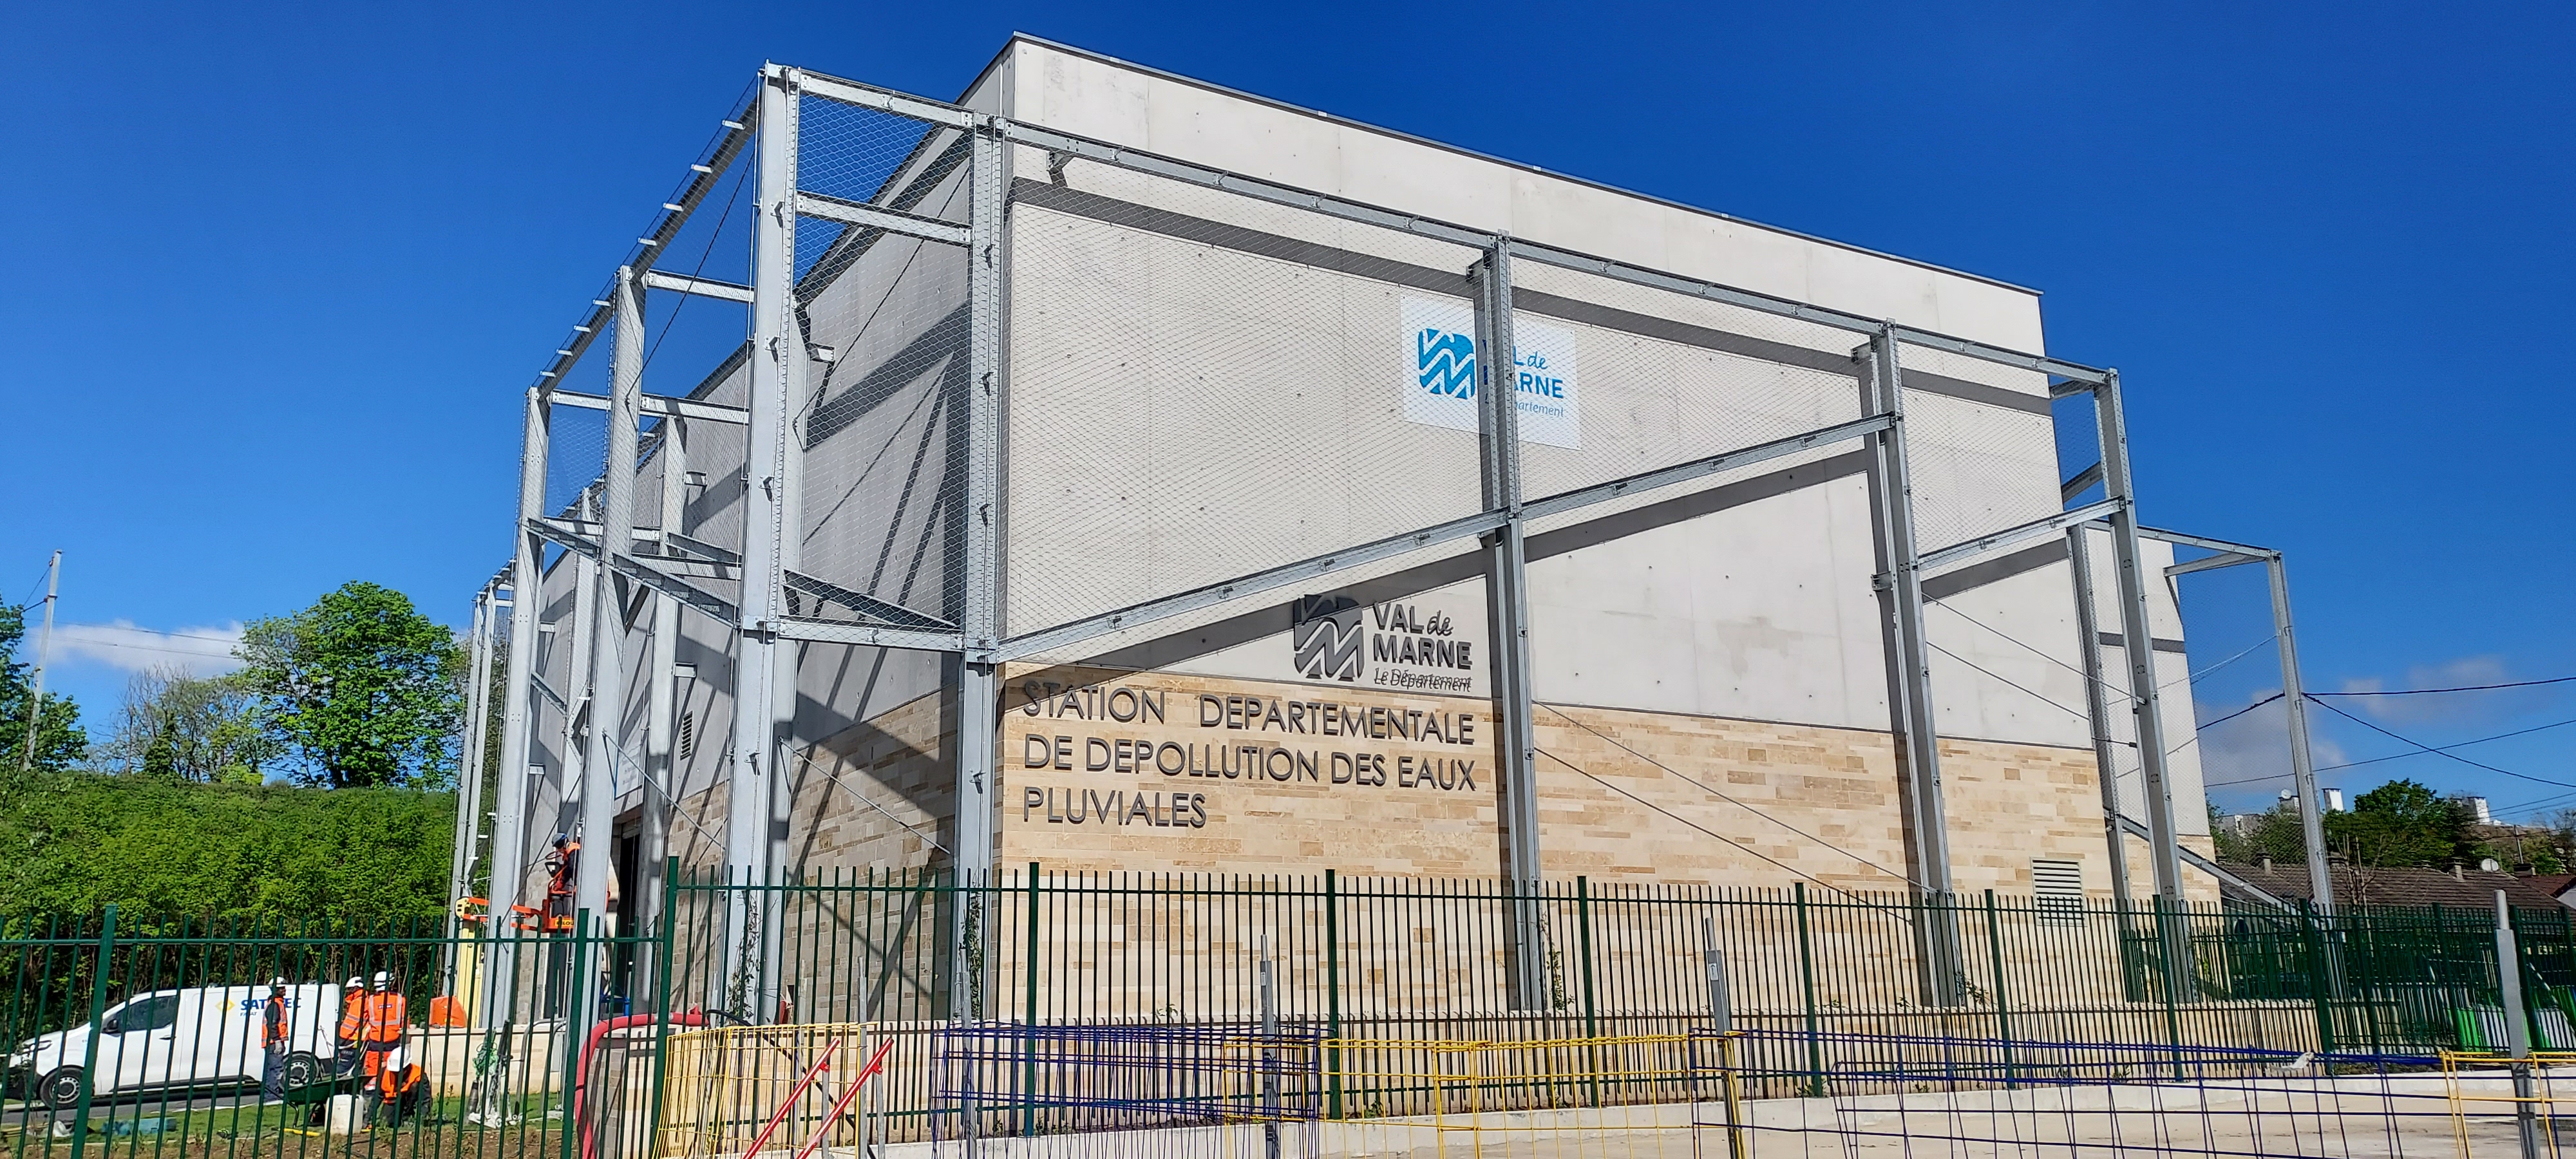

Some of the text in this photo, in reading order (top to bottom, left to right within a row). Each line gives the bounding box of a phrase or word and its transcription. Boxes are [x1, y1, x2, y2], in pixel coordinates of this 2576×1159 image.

[1527, 351, 1548, 370] de
[1373, 602, 1454, 636] VAL de
[1373, 633, 1472, 670] MARNE
[1374, 668, 1472, 692] Le Département
[1023, 679, 1475, 745] STATION DEPARTEMENTALE
[1025, 733, 1477, 791] DE DEPOLLUTION DES EAUX
[1024, 787, 1206, 828] PLUVIALES
